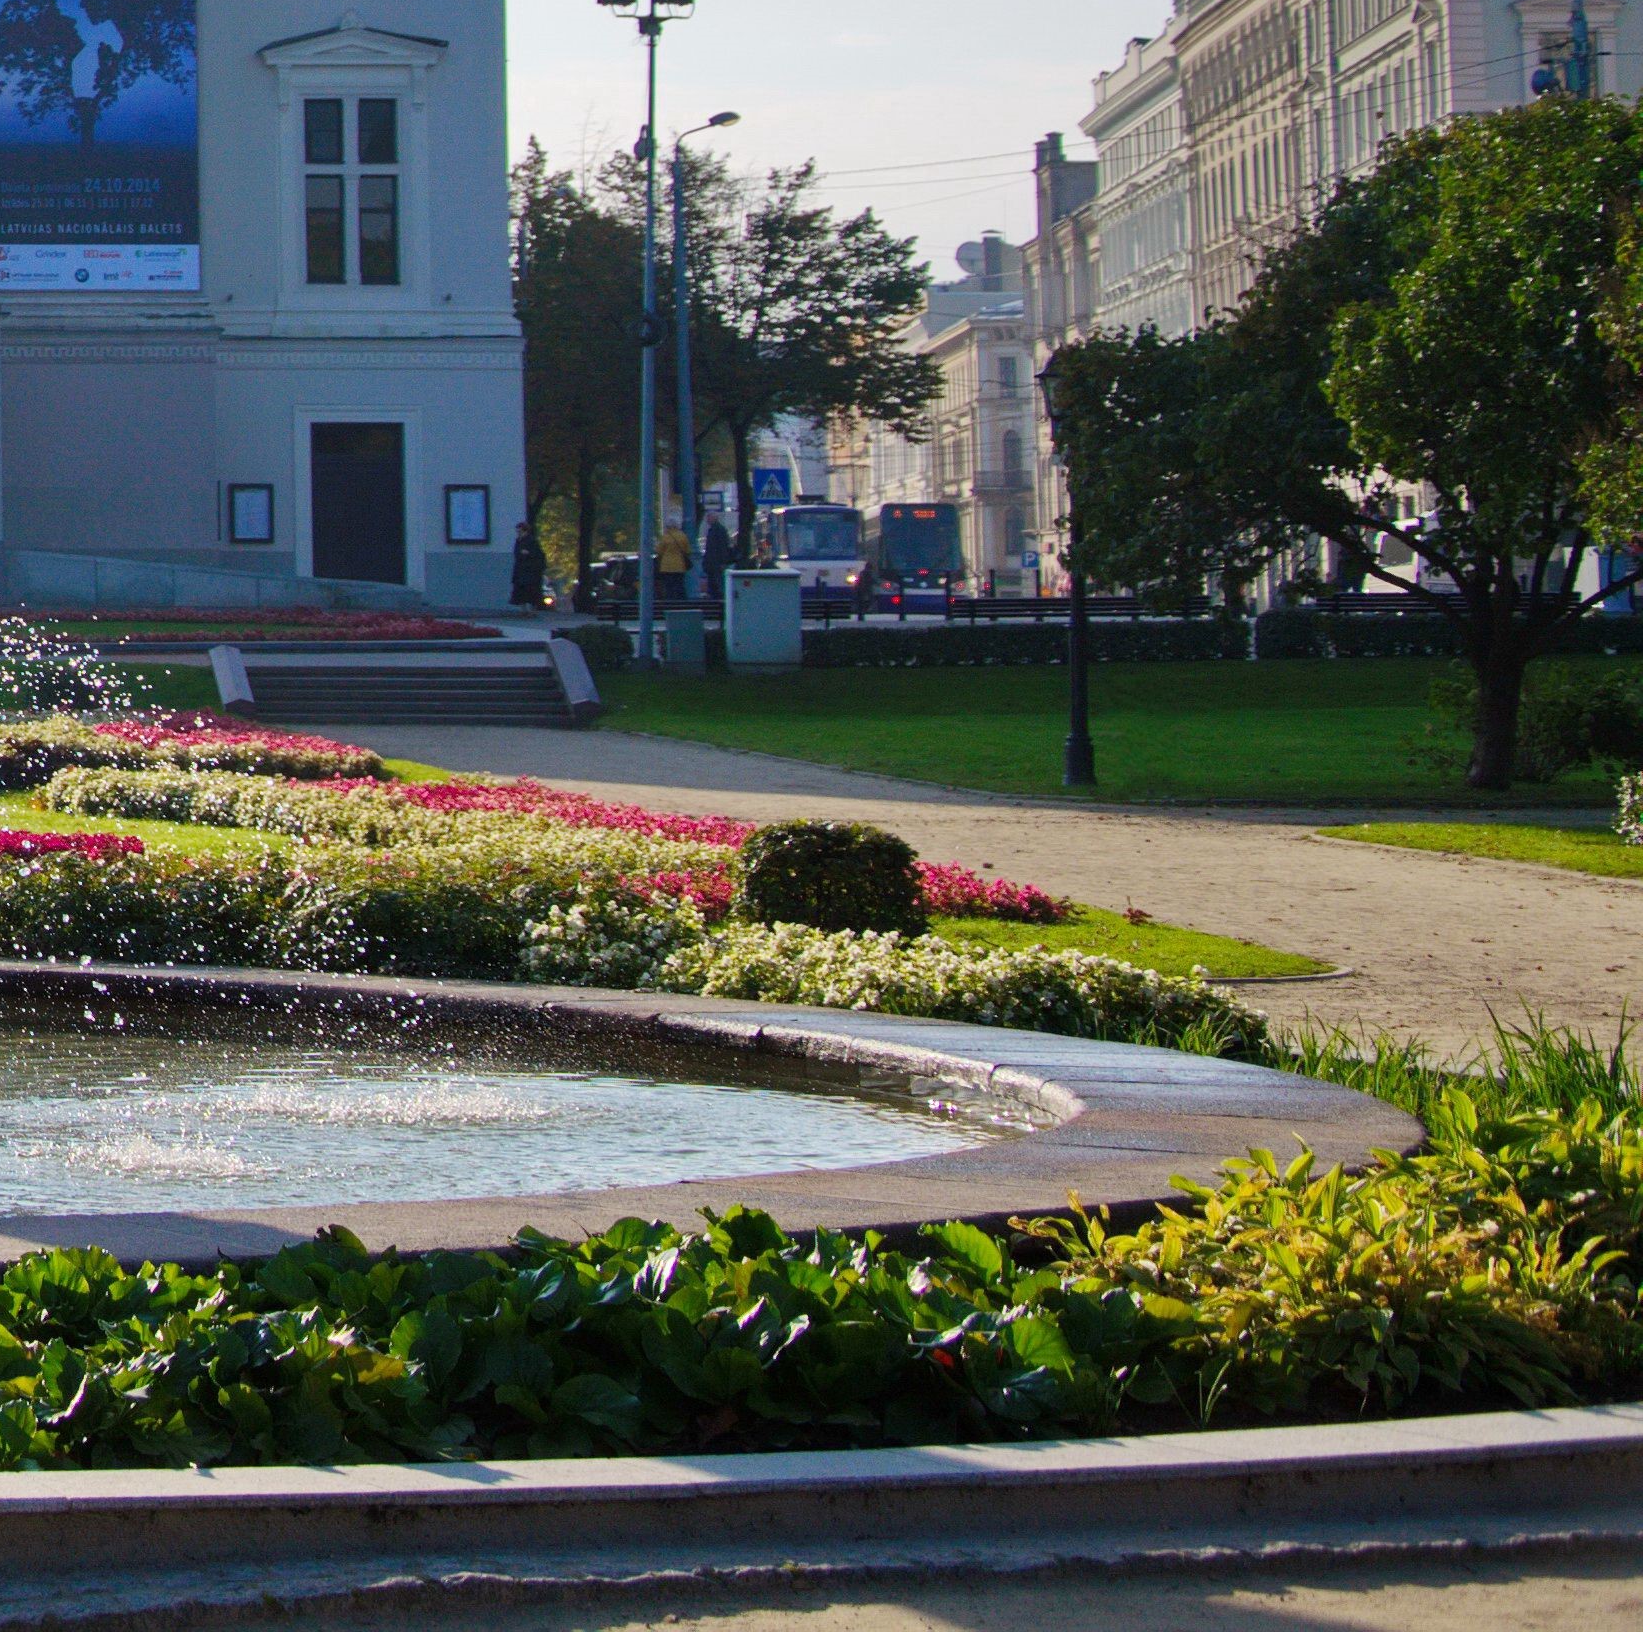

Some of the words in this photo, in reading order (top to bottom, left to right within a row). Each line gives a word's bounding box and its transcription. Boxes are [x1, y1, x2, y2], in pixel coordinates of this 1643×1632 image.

[84, 178, 161, 193] 24.10.2014
[1, 222, 52, 234] LATVIJAS
[57, 221, 135, 234] NACIONĀLAIS
[140, 222, 183, 234] BALETS
